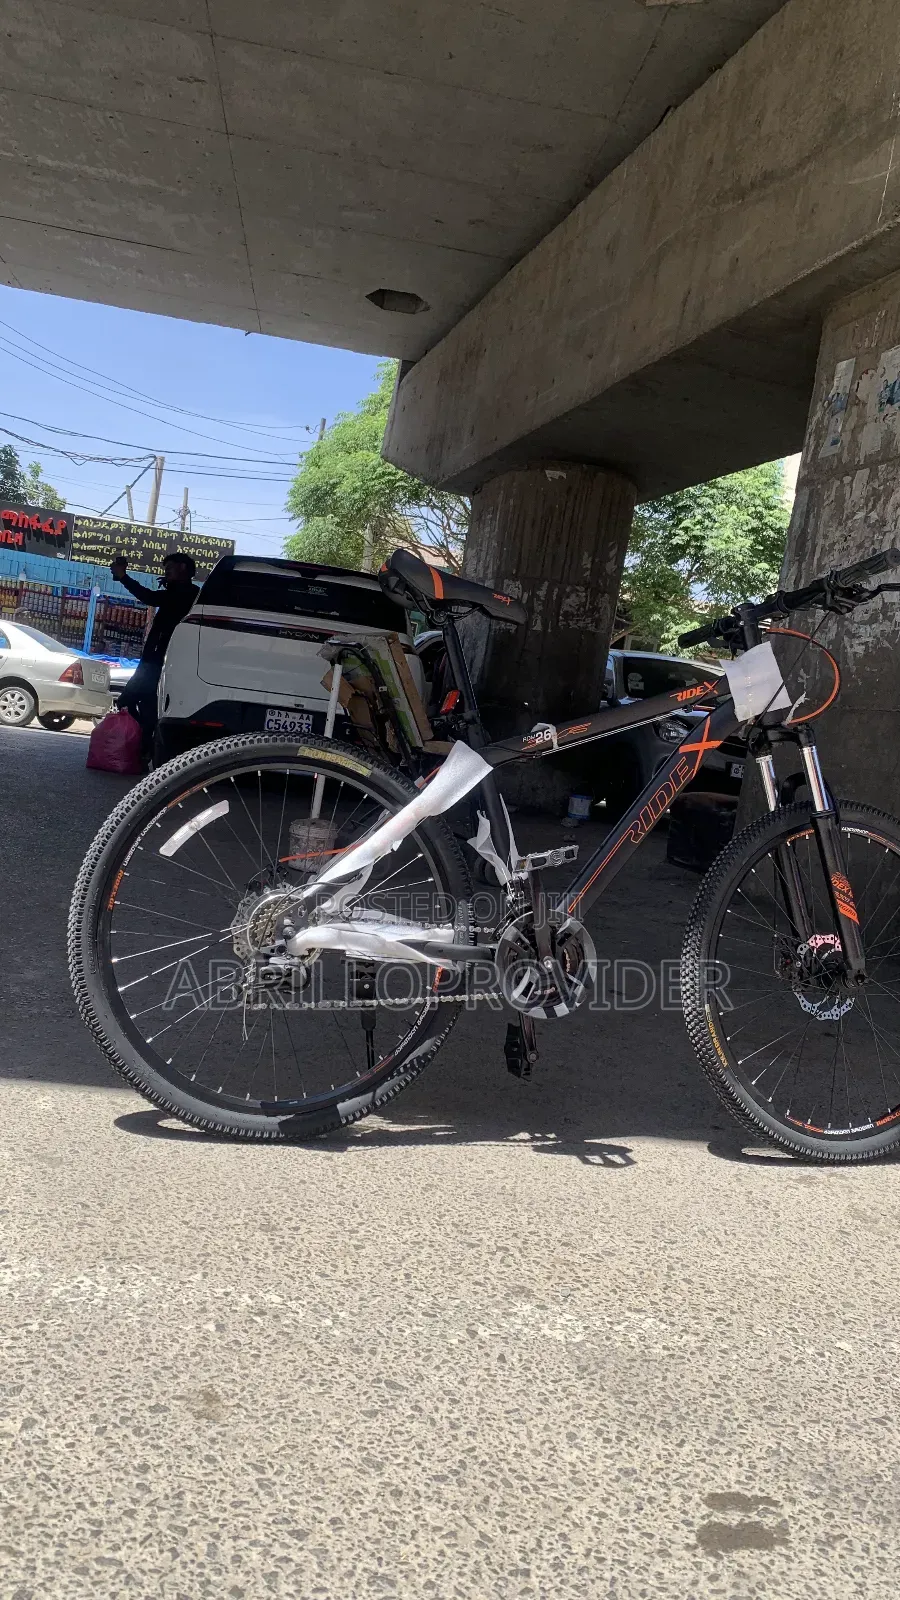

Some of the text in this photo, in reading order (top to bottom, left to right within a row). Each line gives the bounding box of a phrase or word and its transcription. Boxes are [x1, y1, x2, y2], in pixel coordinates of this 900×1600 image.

[279, 630, 319, 640] HYCAN
[670, 680, 718, 701] RIDEX
[266, 719, 311, 732] C54933
[535, 729, 552, 744] 26
